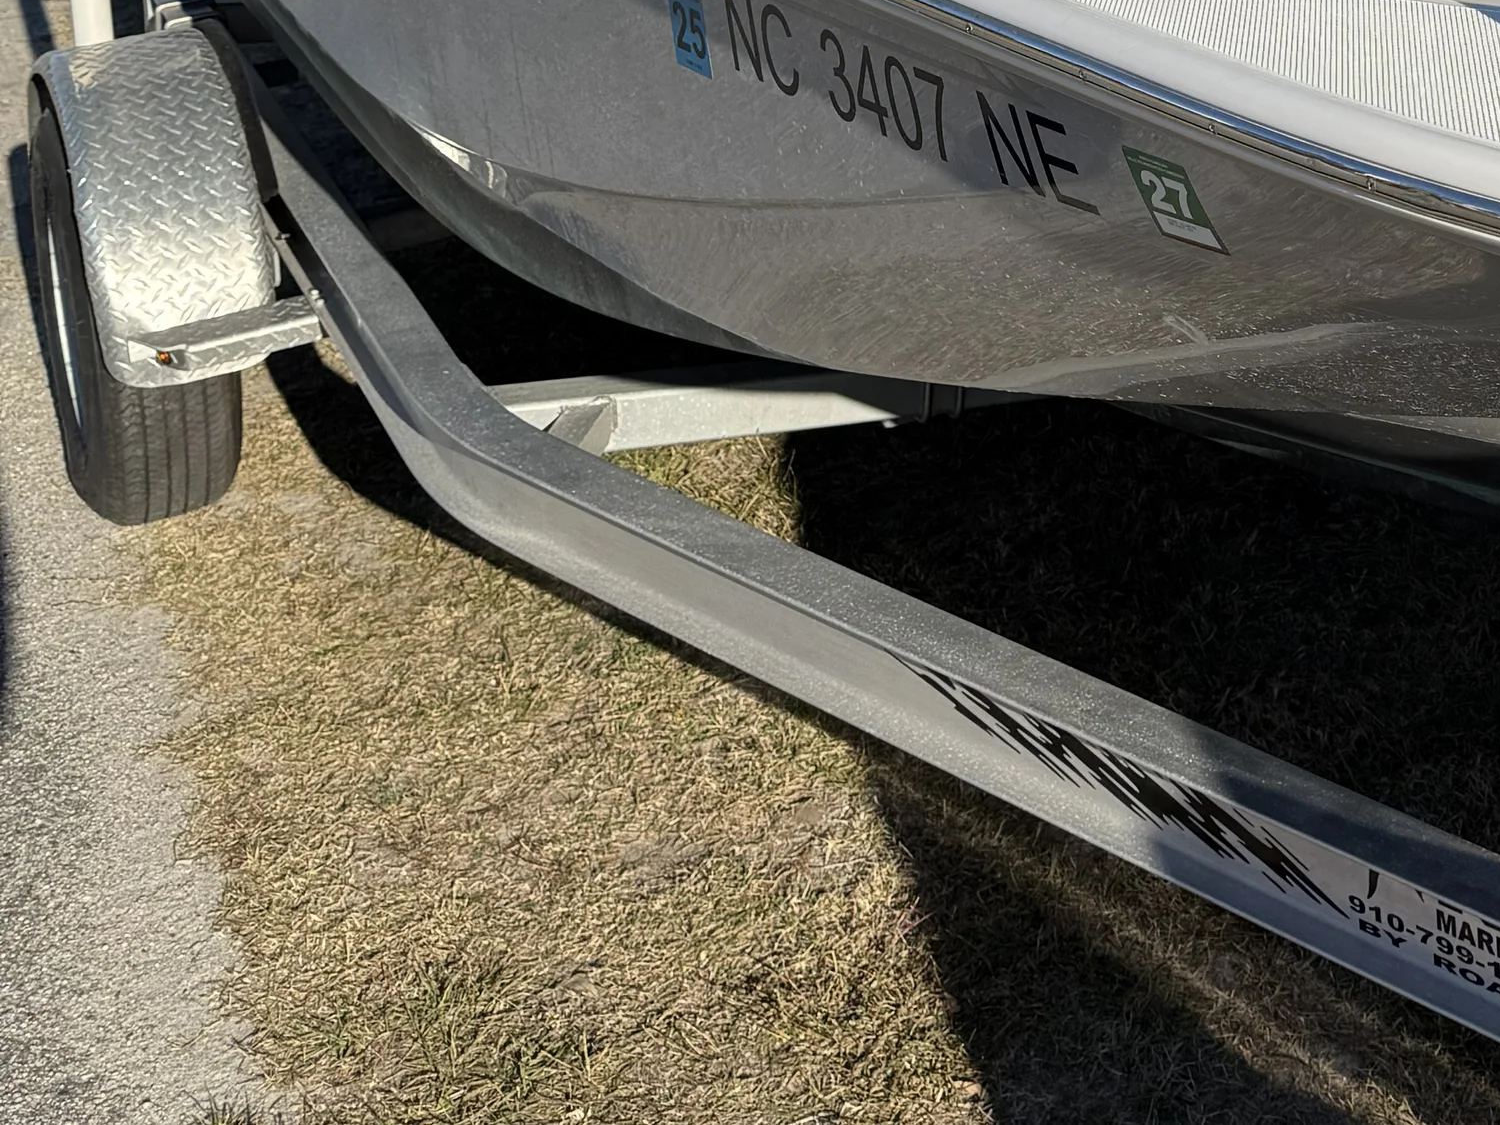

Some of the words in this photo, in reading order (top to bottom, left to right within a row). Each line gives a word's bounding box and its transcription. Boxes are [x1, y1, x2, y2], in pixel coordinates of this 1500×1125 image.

[672, 0, 707, 60] 25
[820, 29, 949, 163] 3407
[976, 90, 1100, 216] NE
[1140, 169, 1194, 220] 27
[1358, 918, 1407, 949] BY
